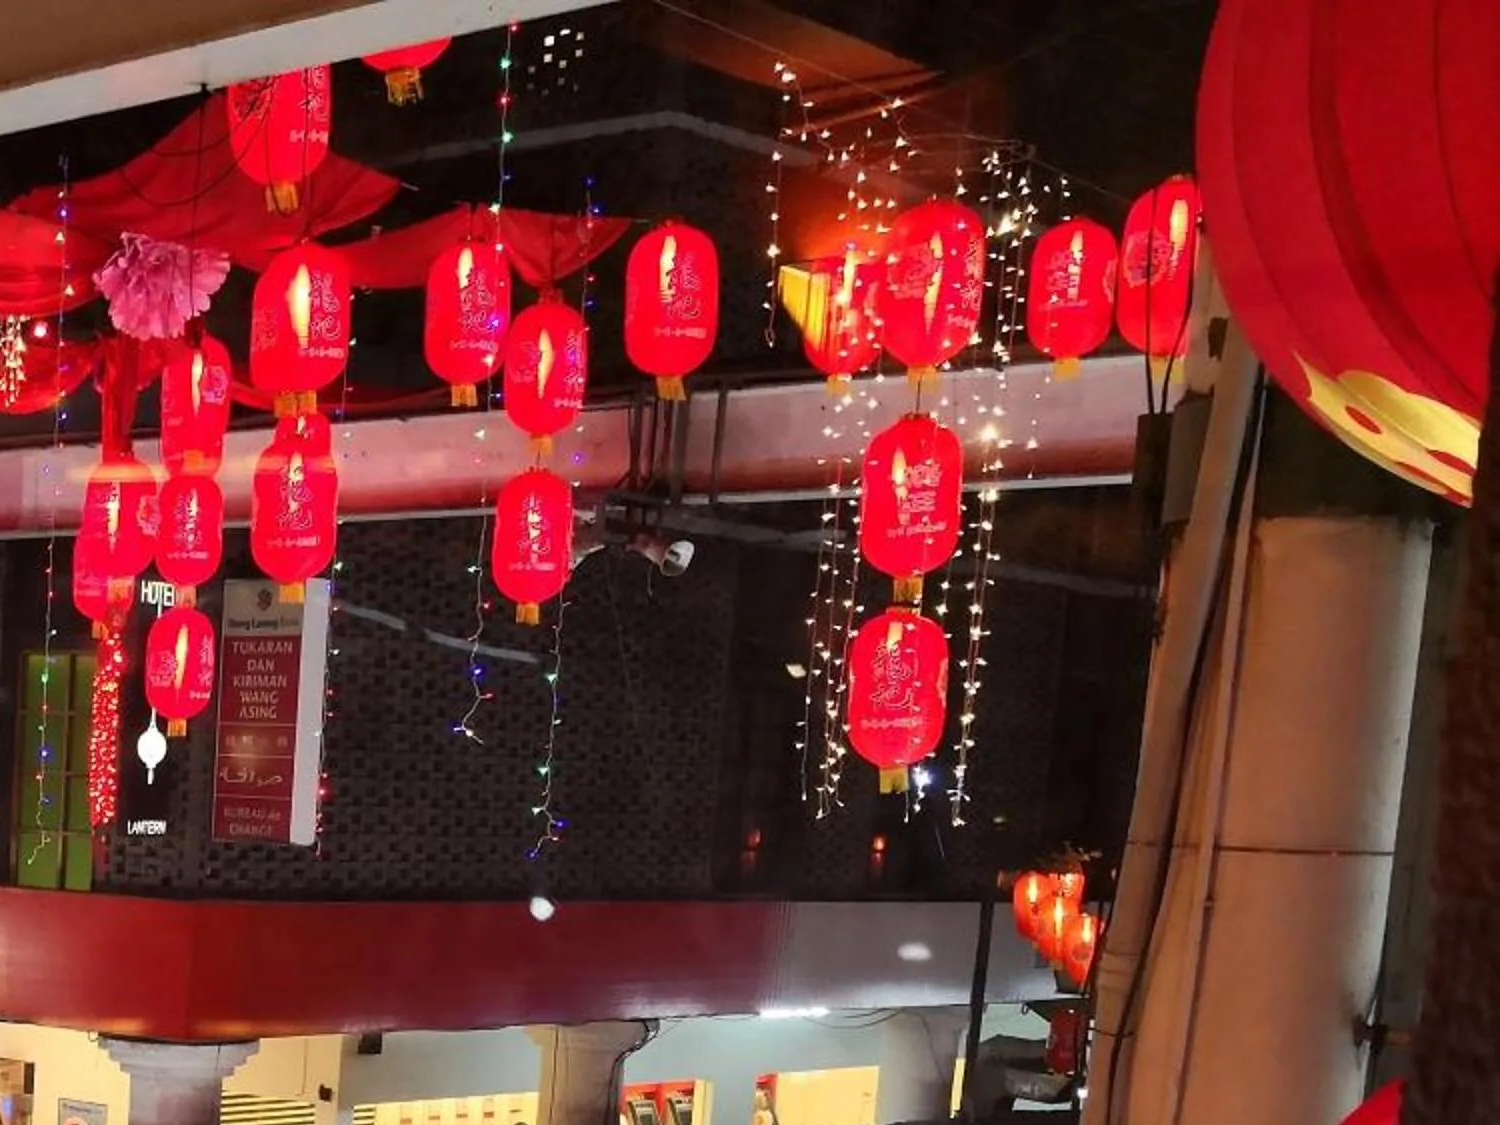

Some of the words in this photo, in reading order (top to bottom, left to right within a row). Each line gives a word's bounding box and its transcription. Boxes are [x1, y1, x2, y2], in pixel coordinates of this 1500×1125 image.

[232, 640, 294, 654] TUKARAN
[246, 658, 275, 672] DAN
[232, 674, 288, 688] KIRIMAN
[239, 690, 280, 704] WANG
[239, 705, 277, 719] ASING
